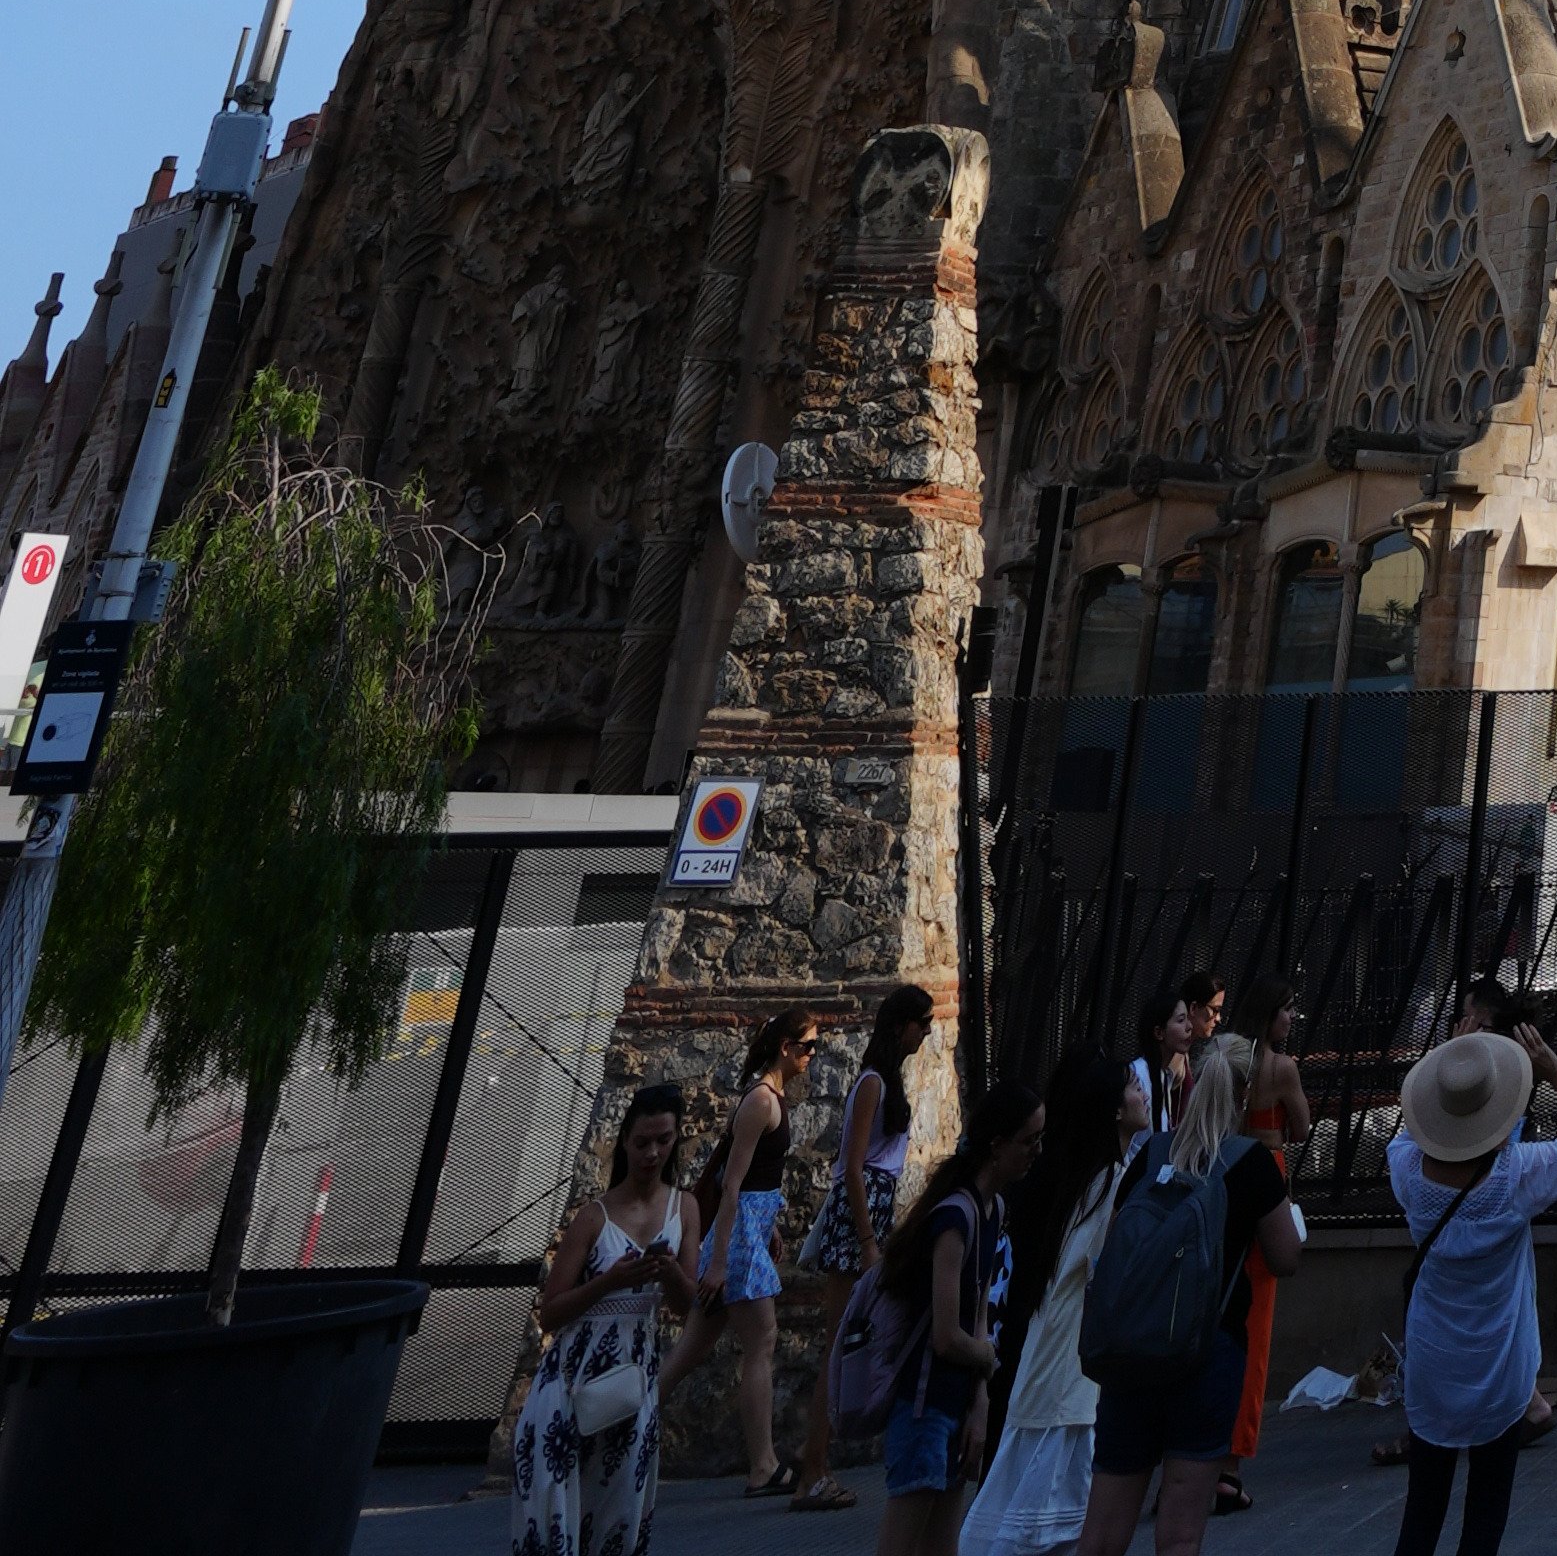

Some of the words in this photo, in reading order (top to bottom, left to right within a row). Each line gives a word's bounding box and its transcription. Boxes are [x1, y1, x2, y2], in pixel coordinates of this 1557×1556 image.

[32, 553, 45, 579] 1
[857, 764, 888, 781] 2267
[681, 860, 690, 873] 0
[701, 859, 731, 873] 24H
